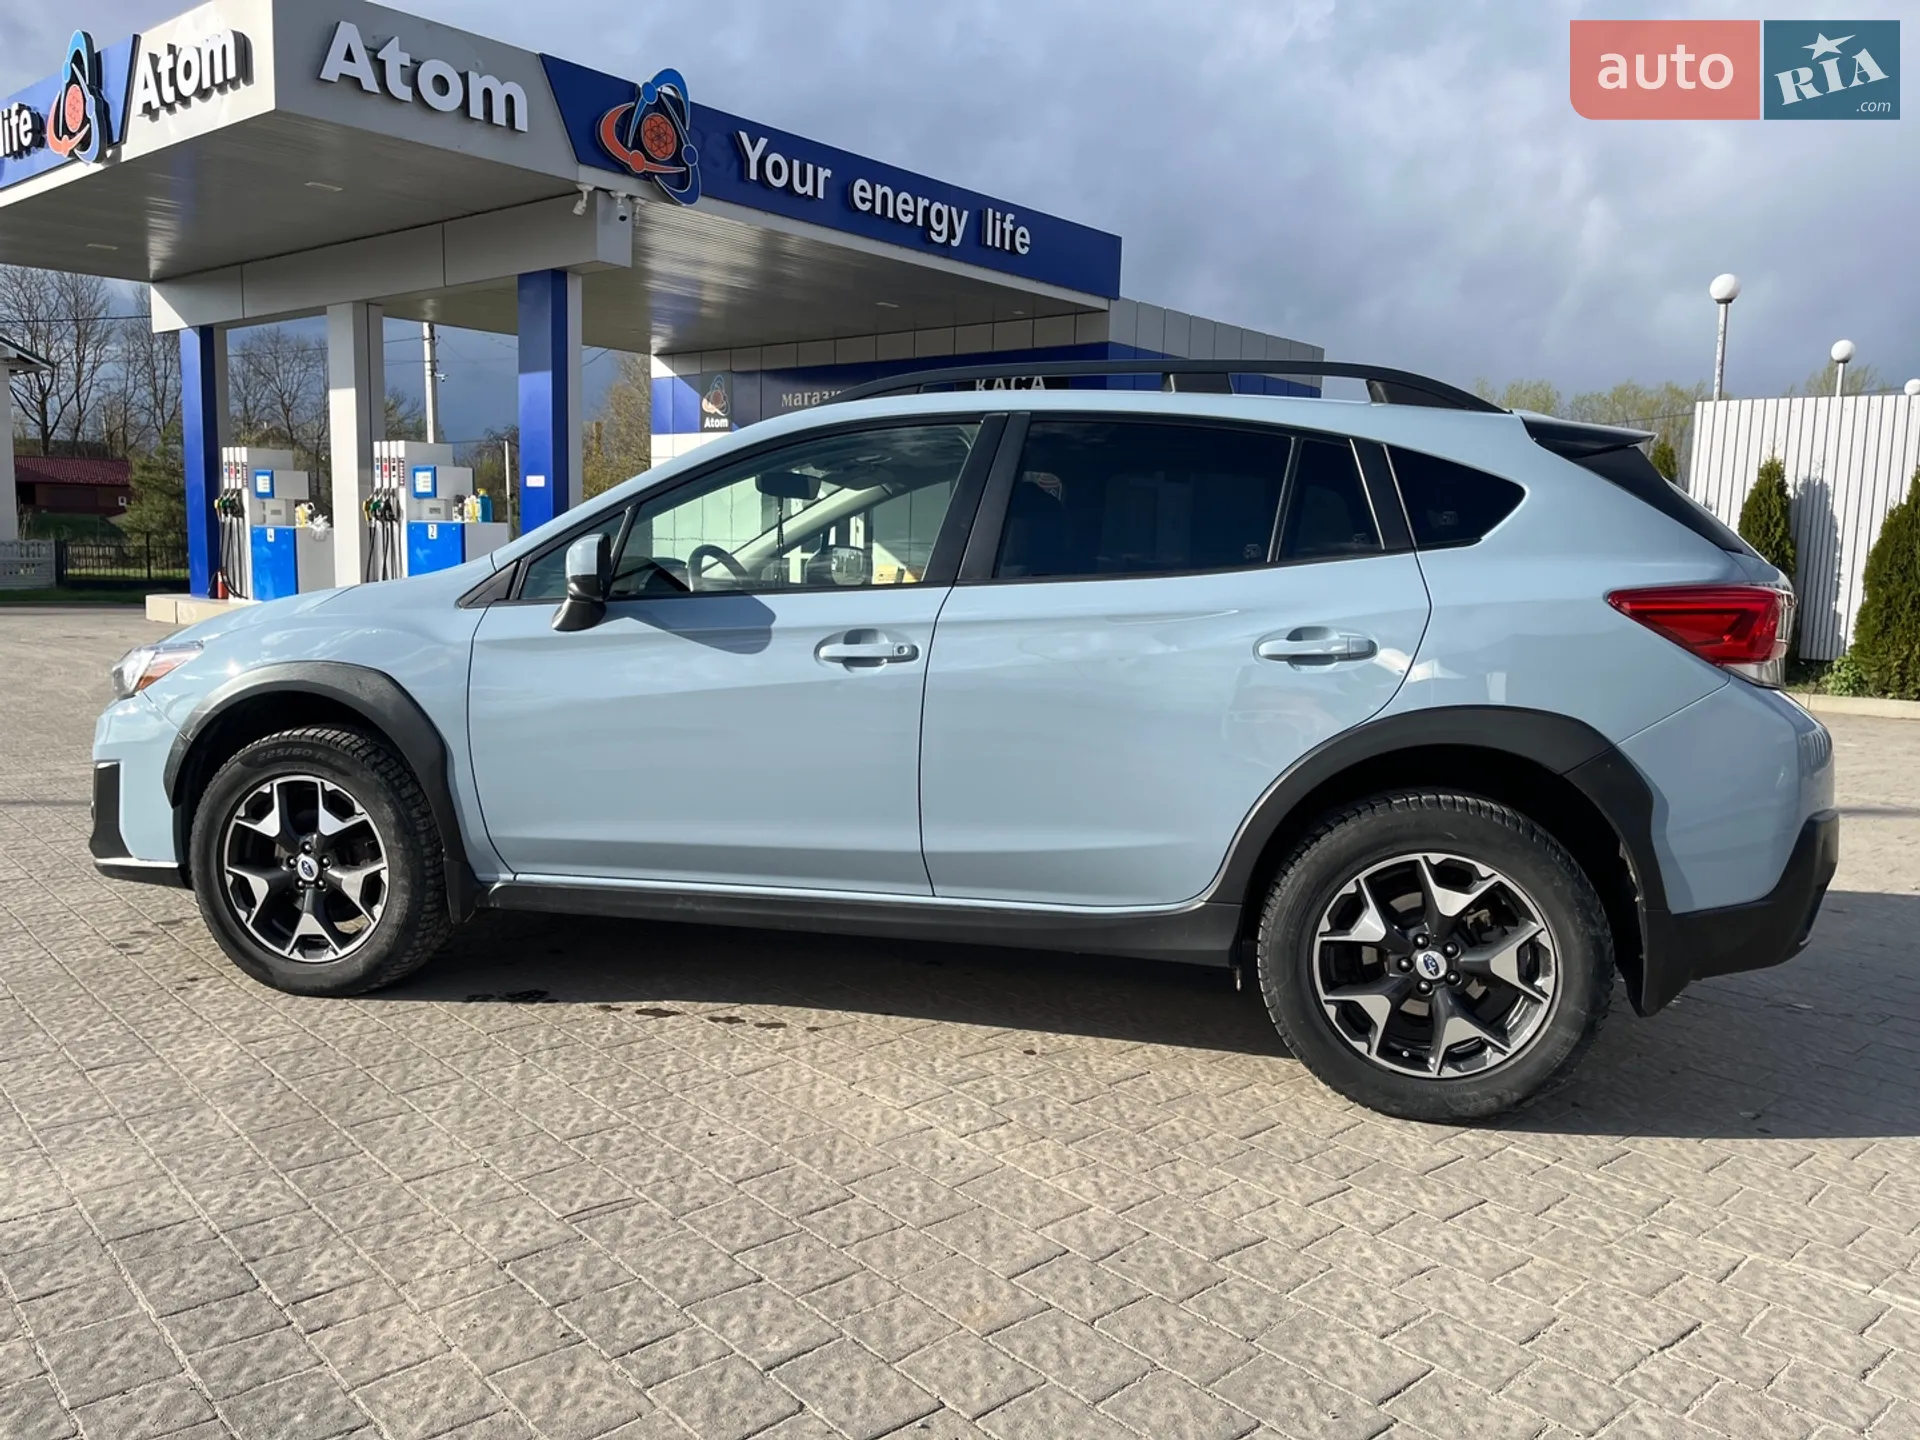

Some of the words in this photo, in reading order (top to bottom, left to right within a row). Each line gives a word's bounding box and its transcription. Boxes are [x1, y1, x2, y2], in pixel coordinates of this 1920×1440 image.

[136, 29, 236, 117] Atom
[320, 20, 528, 132] Atom
[738, 130, 832, 200] Your
[853, 178, 969, 247] energy
[986, 207, 1031, 255] life
[703, 417, 729, 428] Atom
